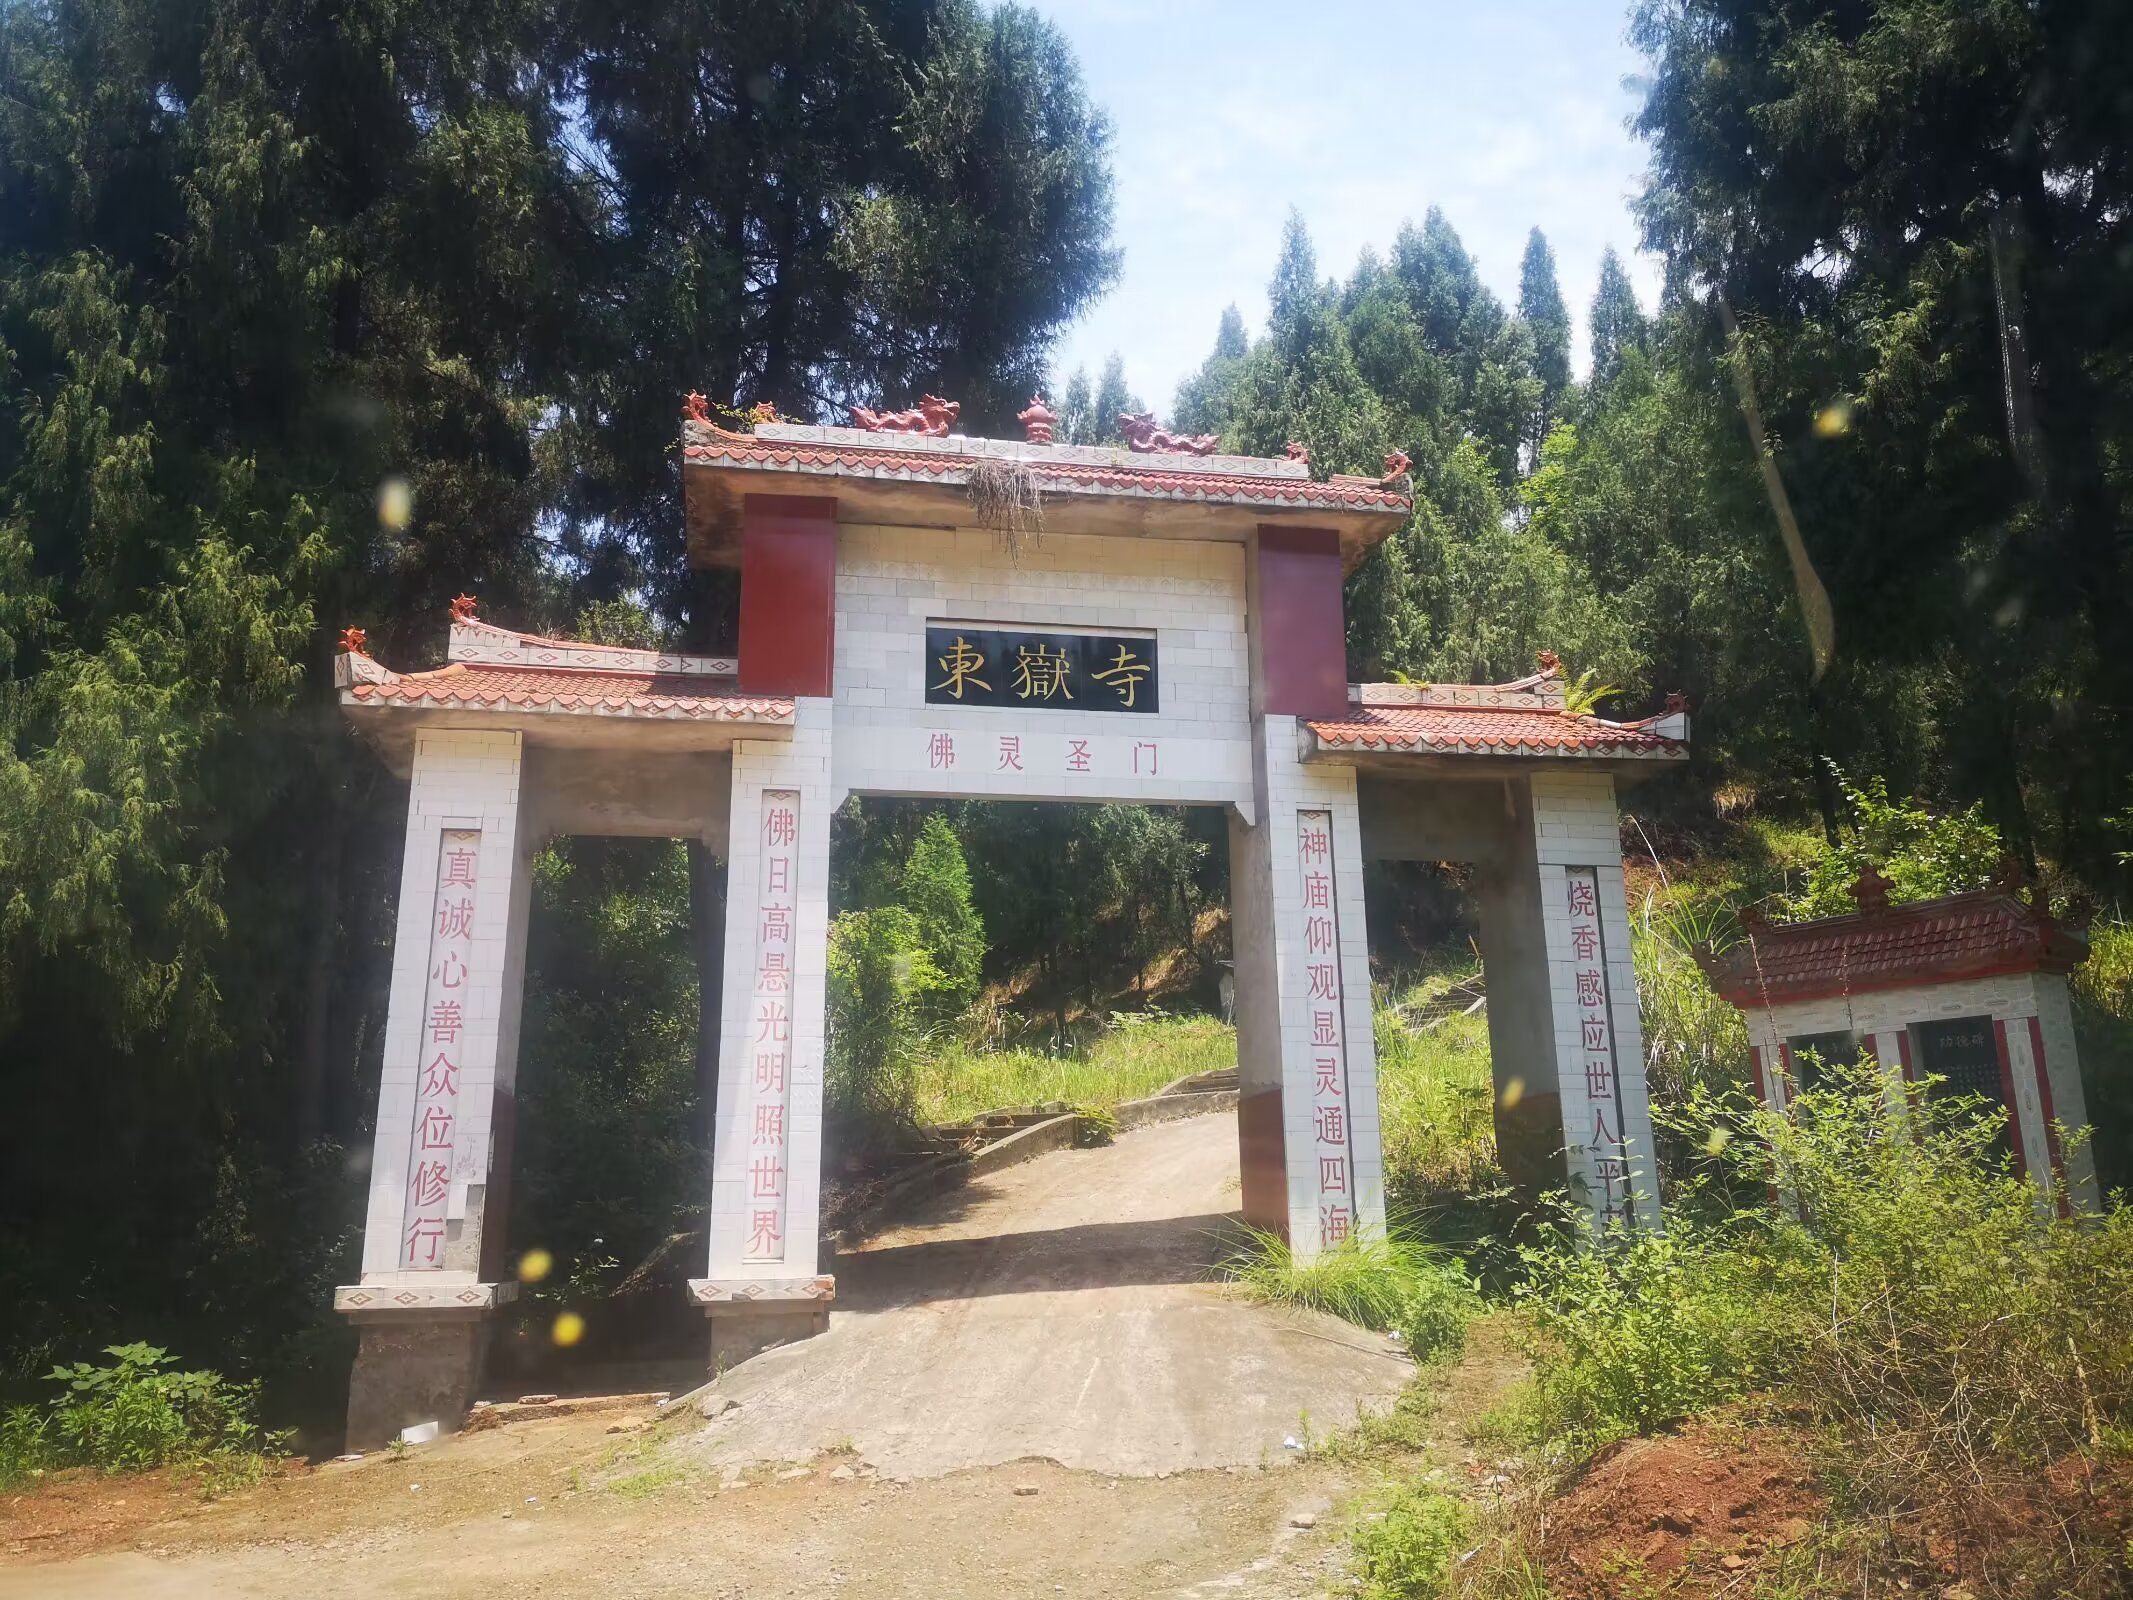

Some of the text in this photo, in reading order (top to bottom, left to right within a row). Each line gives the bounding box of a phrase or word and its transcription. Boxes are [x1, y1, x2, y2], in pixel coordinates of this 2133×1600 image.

[926, 733, 1159, 776] 佛灵圣门
[930, 636, 1151, 707] 東嶽寺
[405, 847, 477, 1264] 真诚心善众位修行
[746, 807, 797, 1256] 佛日高悬光明照世界
[1299, 827, 1350, 1247] 神庙仰观显灵通四海
